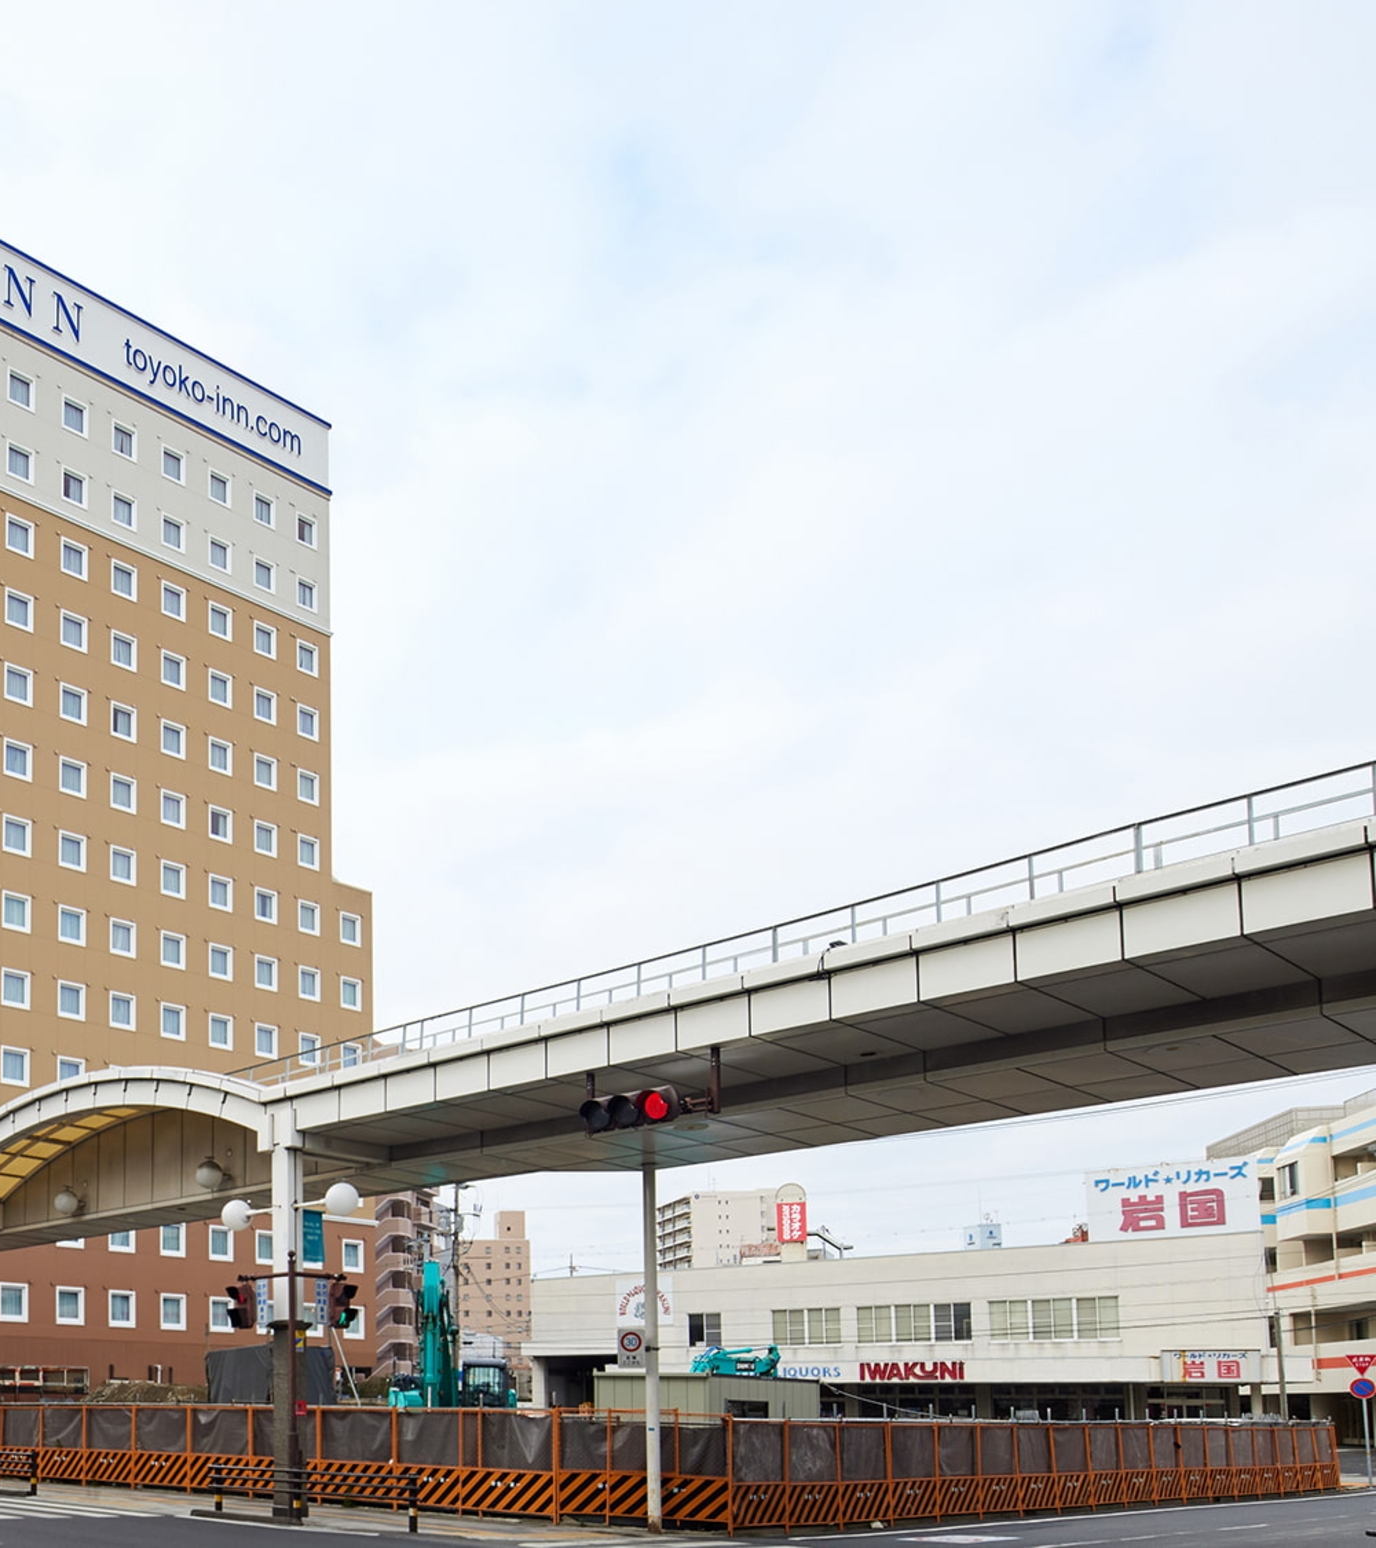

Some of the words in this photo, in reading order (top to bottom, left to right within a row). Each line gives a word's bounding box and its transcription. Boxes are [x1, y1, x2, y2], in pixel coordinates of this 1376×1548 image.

[124, 338, 302, 456] toyoko-inn.com
[790, 1203, 802, 1240] カラオケ
[1119, 1188, 1227, 1233] 岩国
[625, 1337, 638, 1347] 30
[781, 1366, 841, 1379] IQUORS
[1182, 1360, 1241, 1379] 岩国
